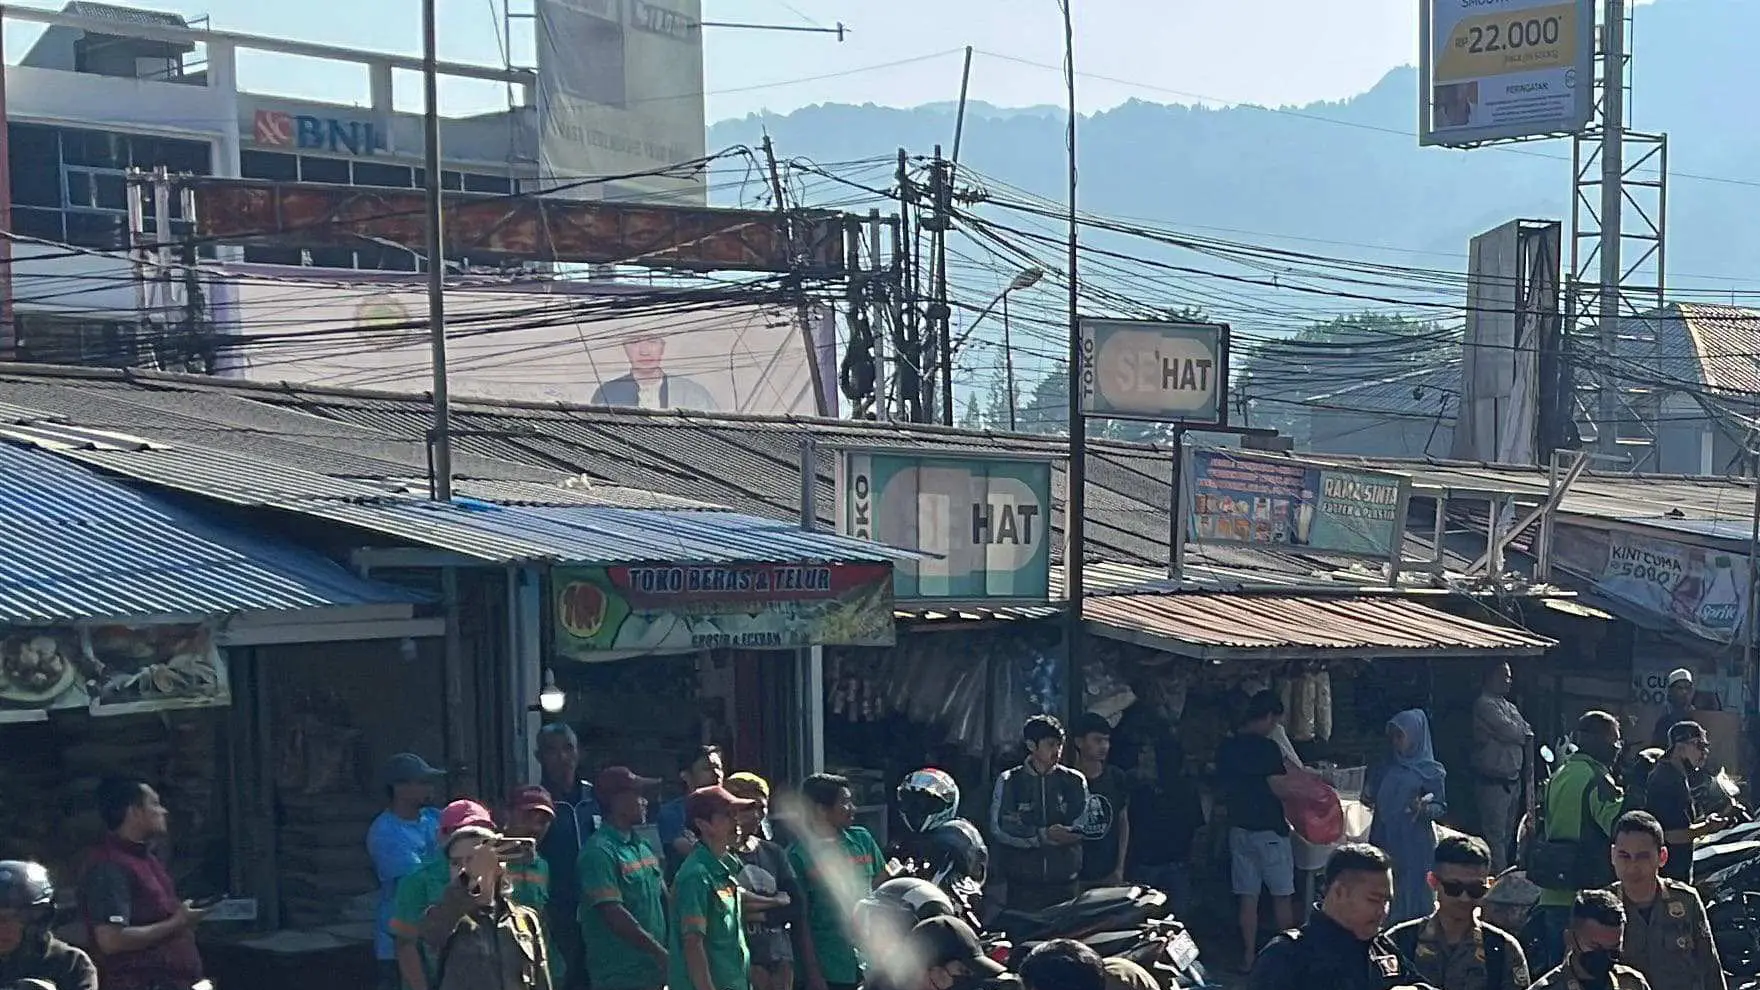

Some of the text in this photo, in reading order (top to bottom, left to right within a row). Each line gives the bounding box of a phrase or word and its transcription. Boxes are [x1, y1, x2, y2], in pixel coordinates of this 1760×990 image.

[293, 115, 374, 155] BNI
[1083, 339, 1094, 399] TOKO
[628, 568, 683, 594] TOKO
[687, 568, 752, 593] BERAS
[773, 567, 831, 592] TELUR
